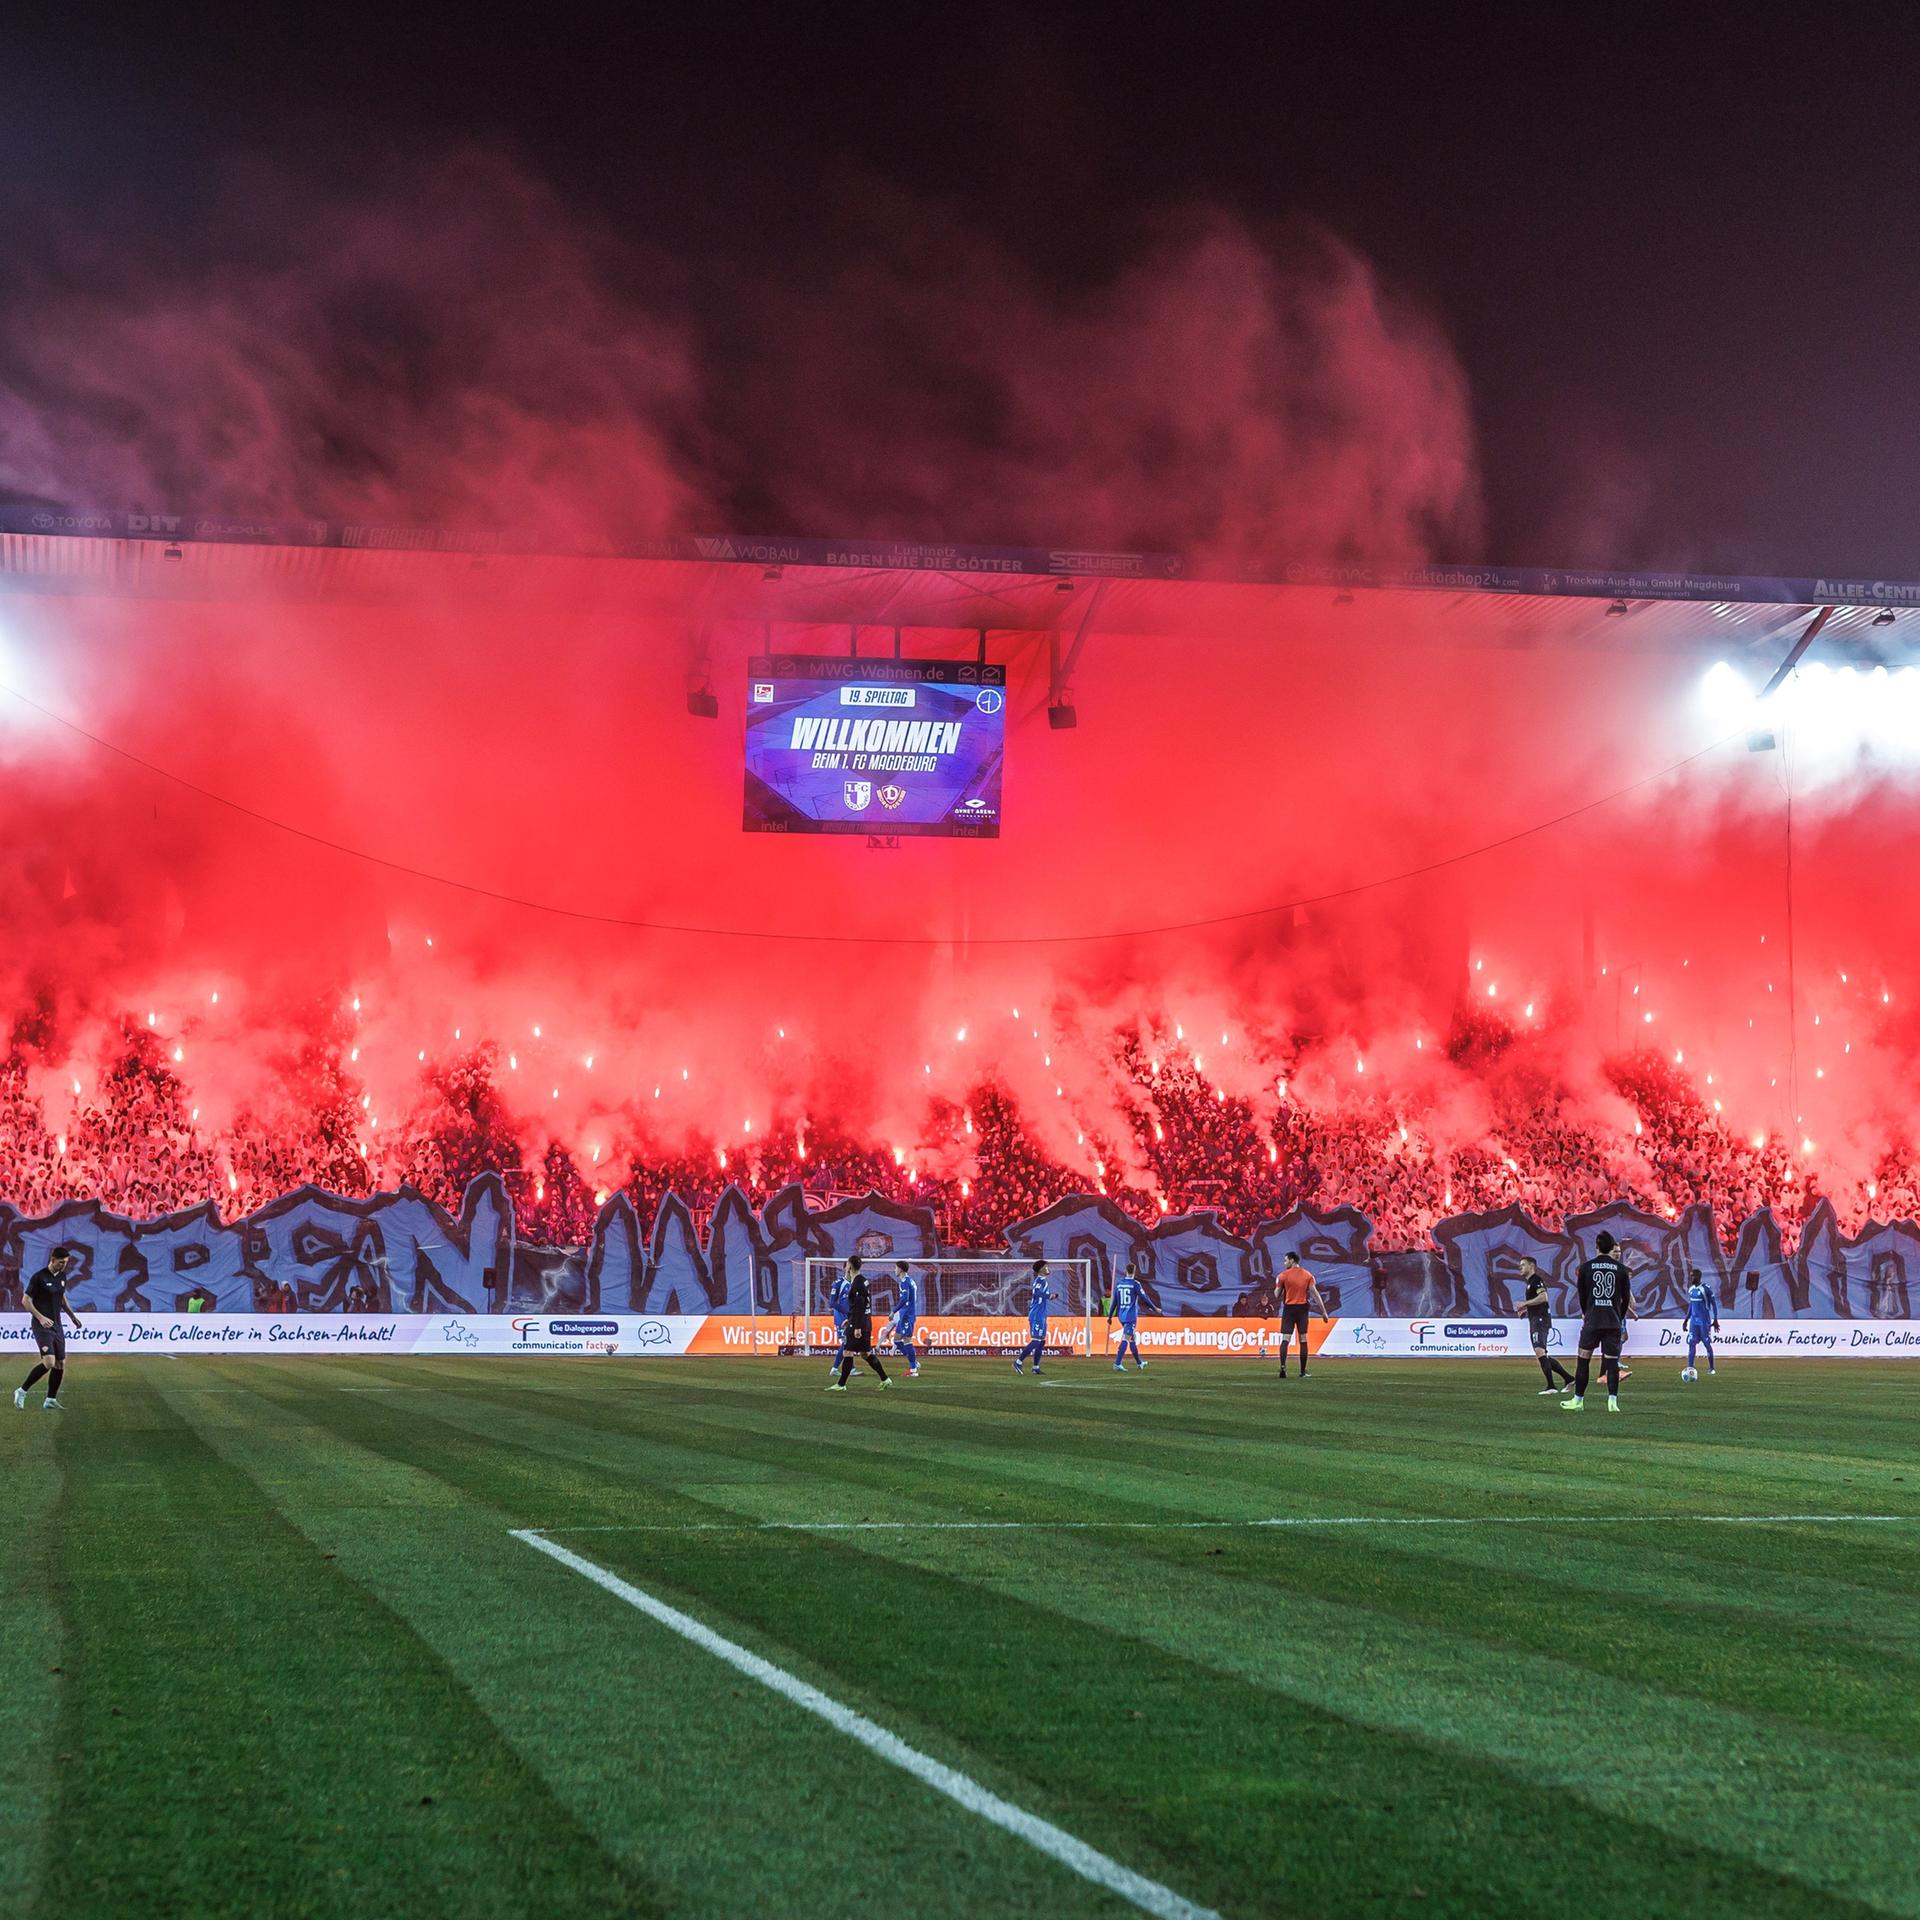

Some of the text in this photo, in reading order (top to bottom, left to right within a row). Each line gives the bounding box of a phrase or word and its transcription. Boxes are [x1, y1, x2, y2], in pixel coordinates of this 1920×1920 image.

[56, 516, 112, 529] TOYOTA
[128, 514, 181, 532] DIT
[218, 525, 278, 537] LEXUS
[736, 546, 799, 561] WOBAU
[1049, 551, 1143, 571] SCHUBERT
[826, 553, 1023, 572] BADEN WIE DIE GÖTTER
[1650, 577, 1682, 589] GmbH
[1684, 579, 1741, 592] Magdeburg
[810, 662, 944, 681] MWG-Wohnen.de
[849, 690, 908, 705] 19. SPIELTAG
[790, 717, 963, 754] WILLKOMMEN
[811, 753, 937, 772] BEIM 1. FC MAGDEBURG
[761, 820, 788, 832] intel
[952, 825, 980, 837] intel
[1591, 1262, 1618, 1271] DRESDEN
[1592, 1270, 1616, 1299] 39
[1118, 1288, 1131, 1305] 16
[63, 1324, 112, 1344] actory
[128, 1323, 164, 1342] Dein
[168, 1324, 243, 1341] Callcenter
[247, 1326, 262, 1341] in
[267, 1323, 397, 1342] Sachsen-Anhalt!
[552, 1324, 616, 1335] Die Dialogexperten
[723, 1326, 752, 1345] Wir
[754, 1326, 816, 1345] suchen
[1446, 1326, 1506, 1338] Die Dialogexperten
[512, 1340, 583, 1350] communication
[1659, 1328, 1682, 1347] Die
[1787, 1329, 1837, 1349] Factory
[1850, 1329, 1880, 1347] Dein
[928, 1346, 987, 1358] dachbleche
[1410, 1342, 1509, 1353] communication factory
